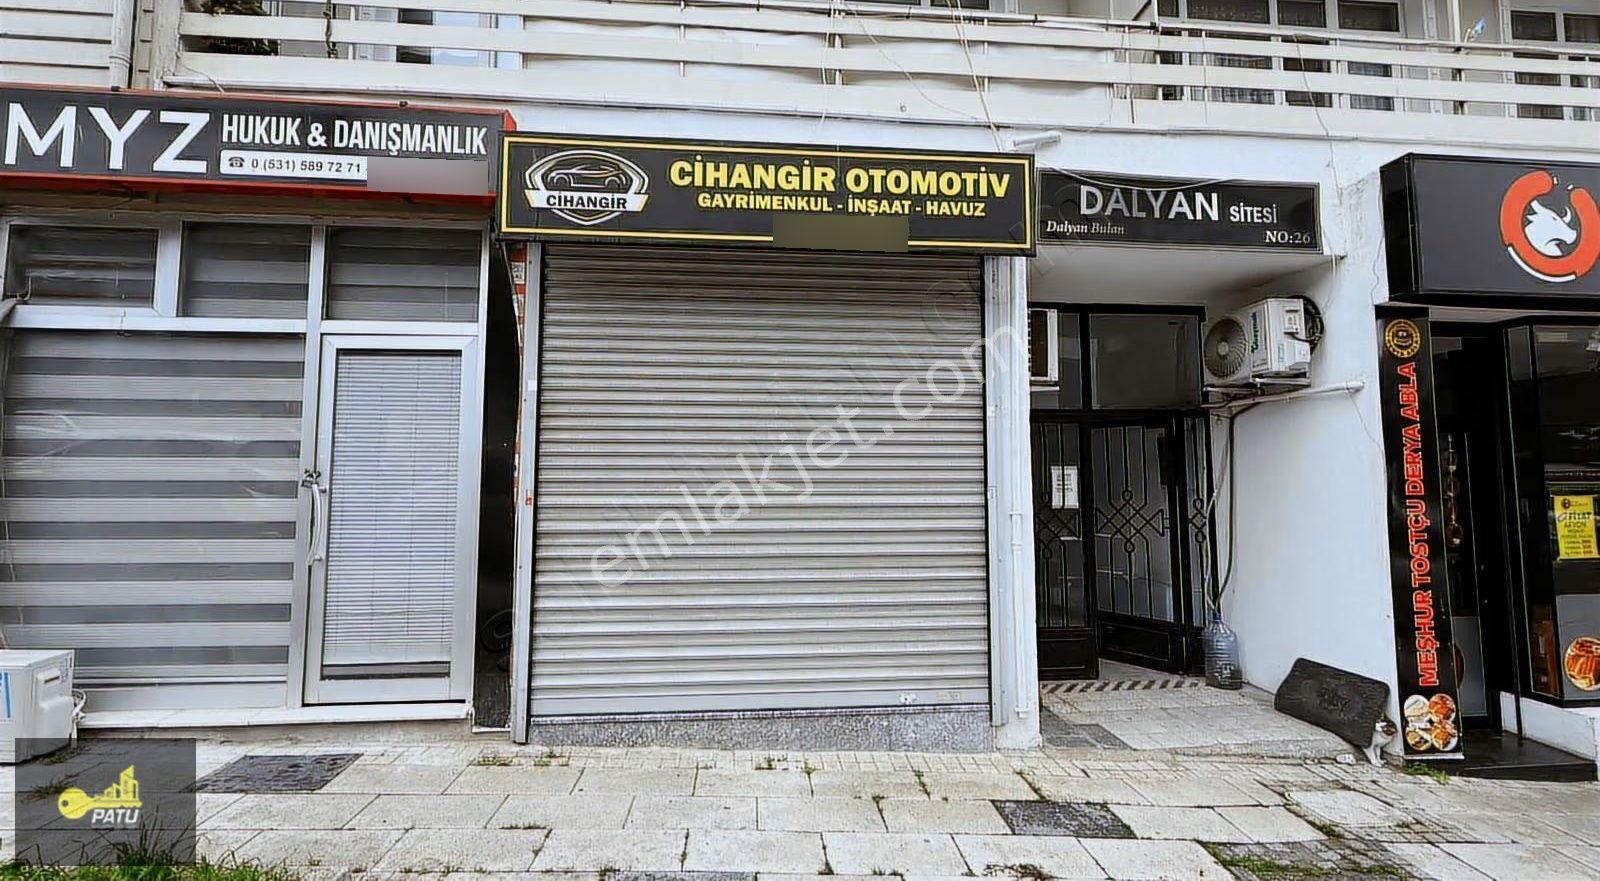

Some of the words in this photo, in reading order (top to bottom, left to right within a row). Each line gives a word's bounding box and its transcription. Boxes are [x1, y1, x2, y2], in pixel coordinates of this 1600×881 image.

[4, 103, 210, 174] MYZ
[222, 114, 302, 147] HUKUK
[309, 123, 328, 148] &
[333, 119, 488, 156] DANIŞMANLIK
[251, 159, 259, 171] 0
[263, 158, 296, 173] (531)
[299, 160, 323, 173] 589
[326, 161, 343, 173] 72
[346, 162, 362, 173] 71
[669, 154, 837, 194] CİHANGİR
[845, 165, 1011, 199] OTOMOTİV
[546, 193, 628, 211] CİHANGİR
[697, 190, 833, 213] GAYRİMENKUL
[848, 196, 912, 217] İNŞAAT
[926, 201, 987, 217] HAVUZ
[1080, 185, 1219, 221] DALYAN
[1229, 202, 1278, 225] SİTESİ
[1046, 220, 1088, 236] Dalyan
[1264, 230, 1311, 244] NO:26
[1397, 361, 1420, 421] ABLA
[1402, 424, 1424, 495] DERYA
[1406, 499, 1430, 587] TOSTÇU
[1413, 590, 1439, 687] MEŞHUR
